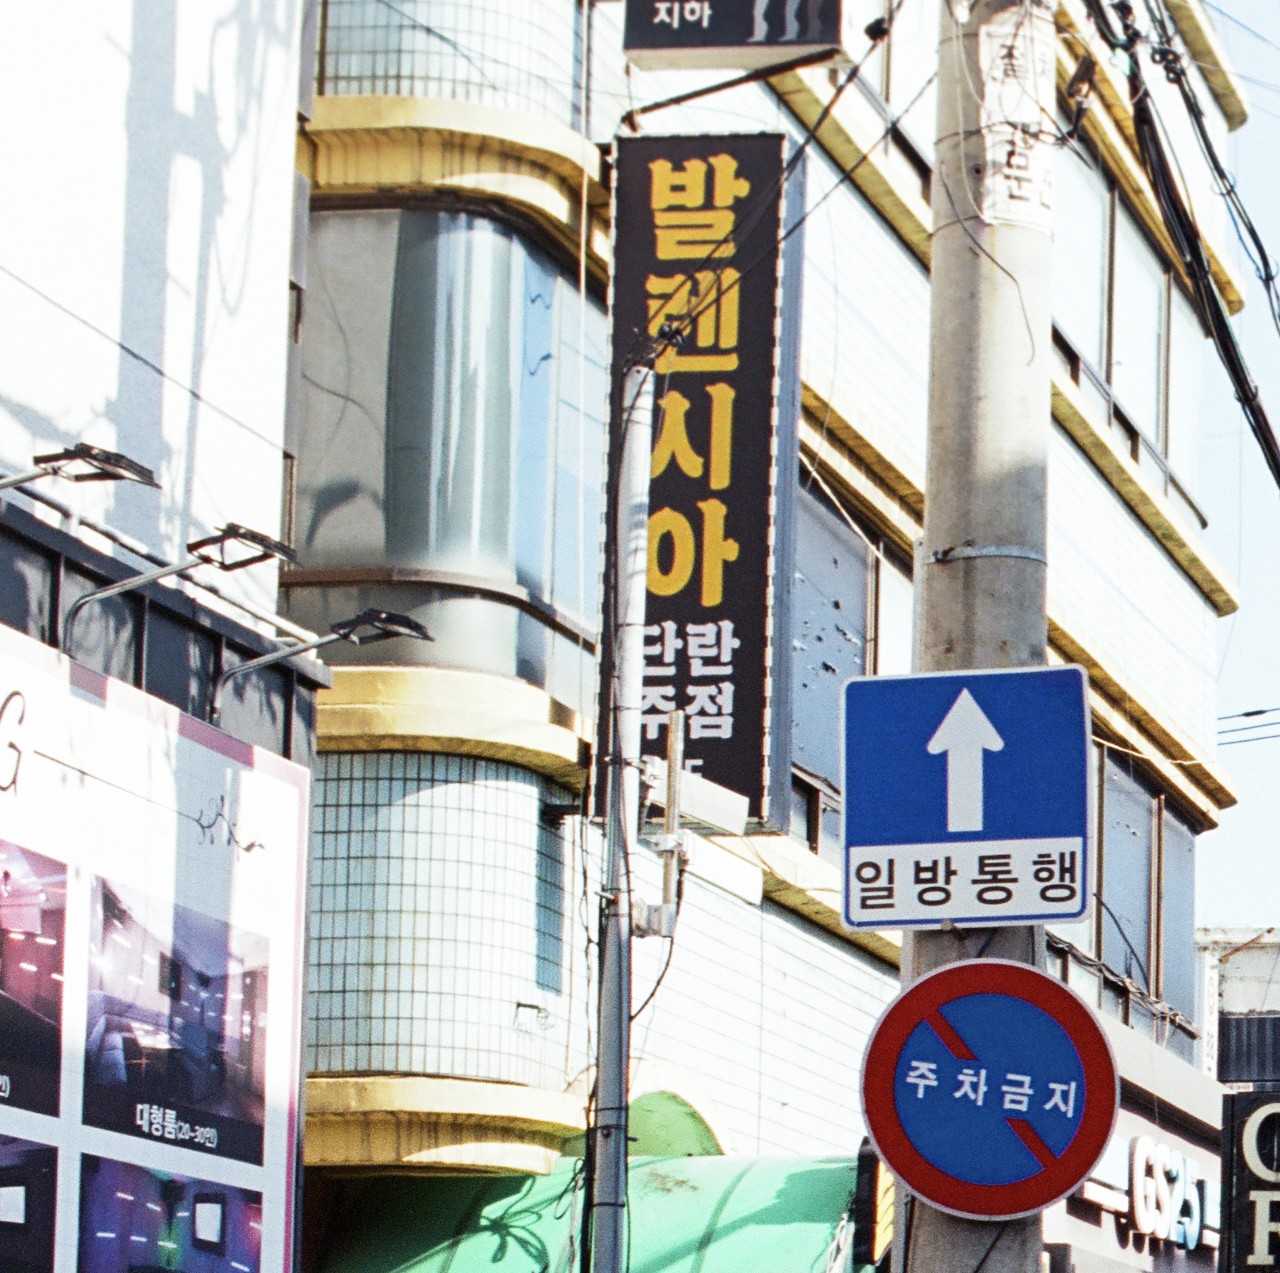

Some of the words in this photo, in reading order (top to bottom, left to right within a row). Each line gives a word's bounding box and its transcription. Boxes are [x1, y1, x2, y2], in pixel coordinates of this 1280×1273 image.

[653, 2, 712, 30] 지하
[645, 153, 752, 608] 발렌시아
[643, 620, 741, 677] 단란
[641, 681, 736, 740] 주점
[853, 849, 1080, 911] 일방통행
[905, 1057, 1079, 1121] 주차금지
